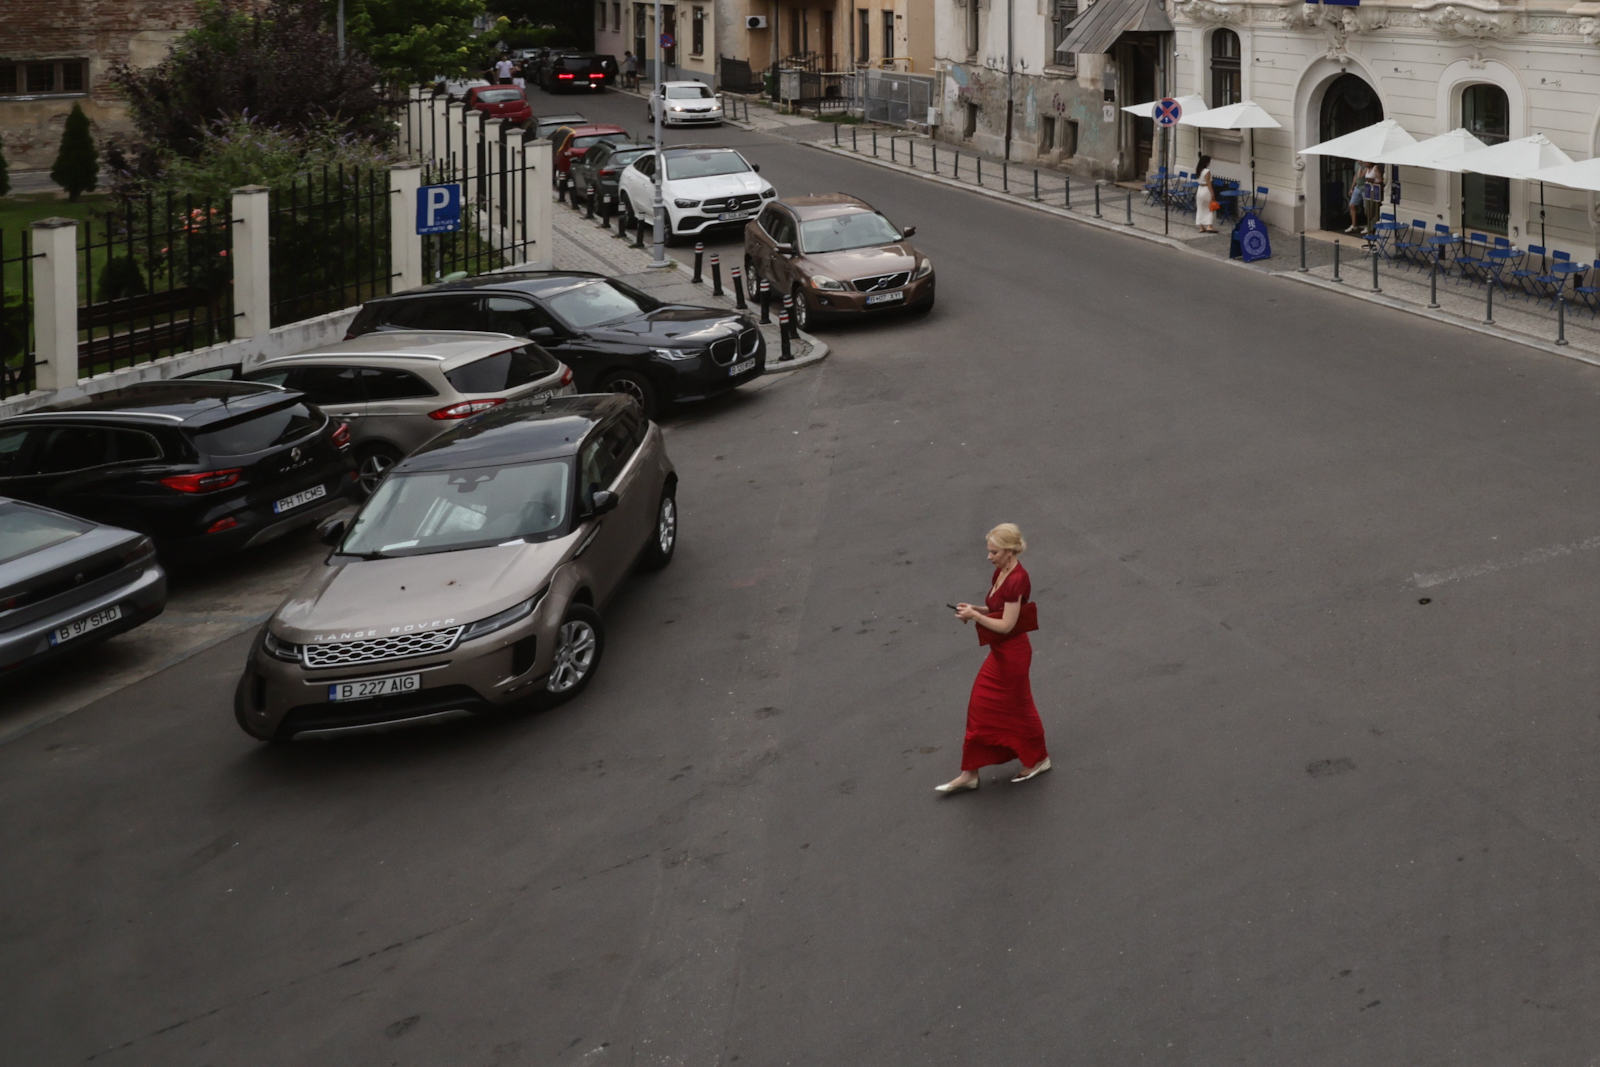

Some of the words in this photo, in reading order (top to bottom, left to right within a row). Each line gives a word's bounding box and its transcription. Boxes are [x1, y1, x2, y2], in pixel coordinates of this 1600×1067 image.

[427, 187, 450, 226] P
[279, 497, 293, 510] PH
[304, 486, 323, 500] CMS
[60, 627, 70, 640] B
[73, 619, 87, 633] 97
[91, 608, 117, 627] SHD
[314, 629, 377, 641] RANGE
[390, 618, 455, 633] ROVER
[342, 684, 353, 698] B
[359, 680, 386, 696] 227
[390, 676, 415, 692] AIG
